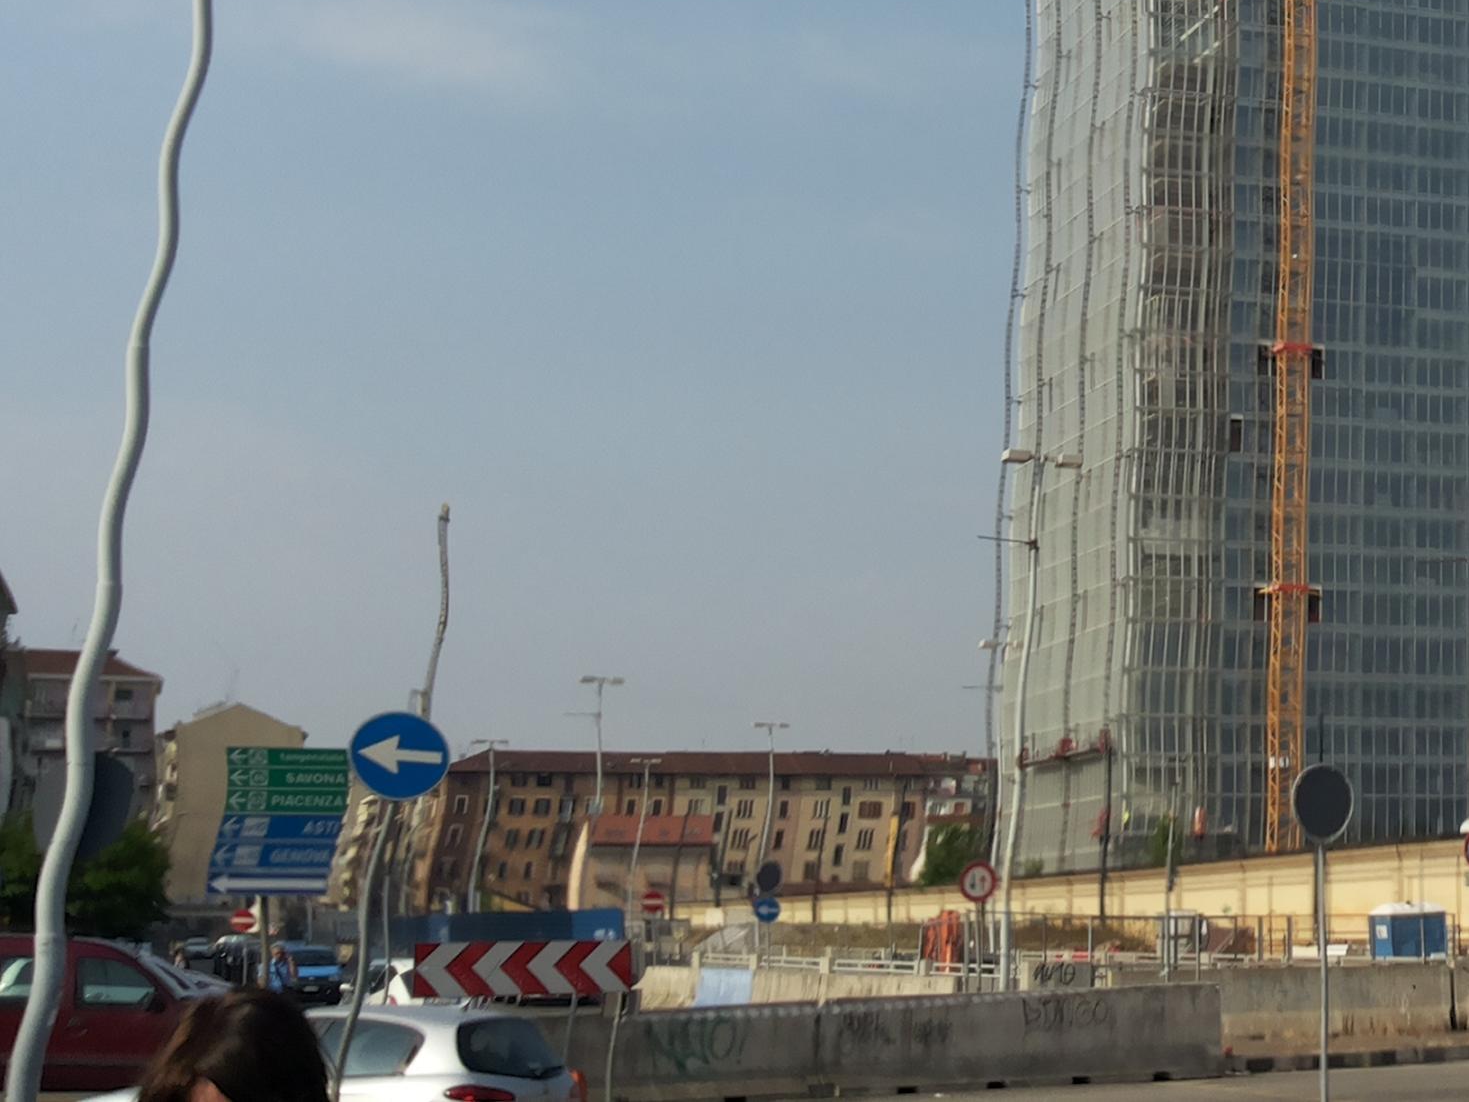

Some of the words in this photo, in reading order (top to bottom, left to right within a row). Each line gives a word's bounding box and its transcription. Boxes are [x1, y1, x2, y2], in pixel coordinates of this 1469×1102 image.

[286, 772, 345, 784] SAVONA
[271, 794, 343, 807] PIACENZA
[303, 819, 340, 835] ASTI
